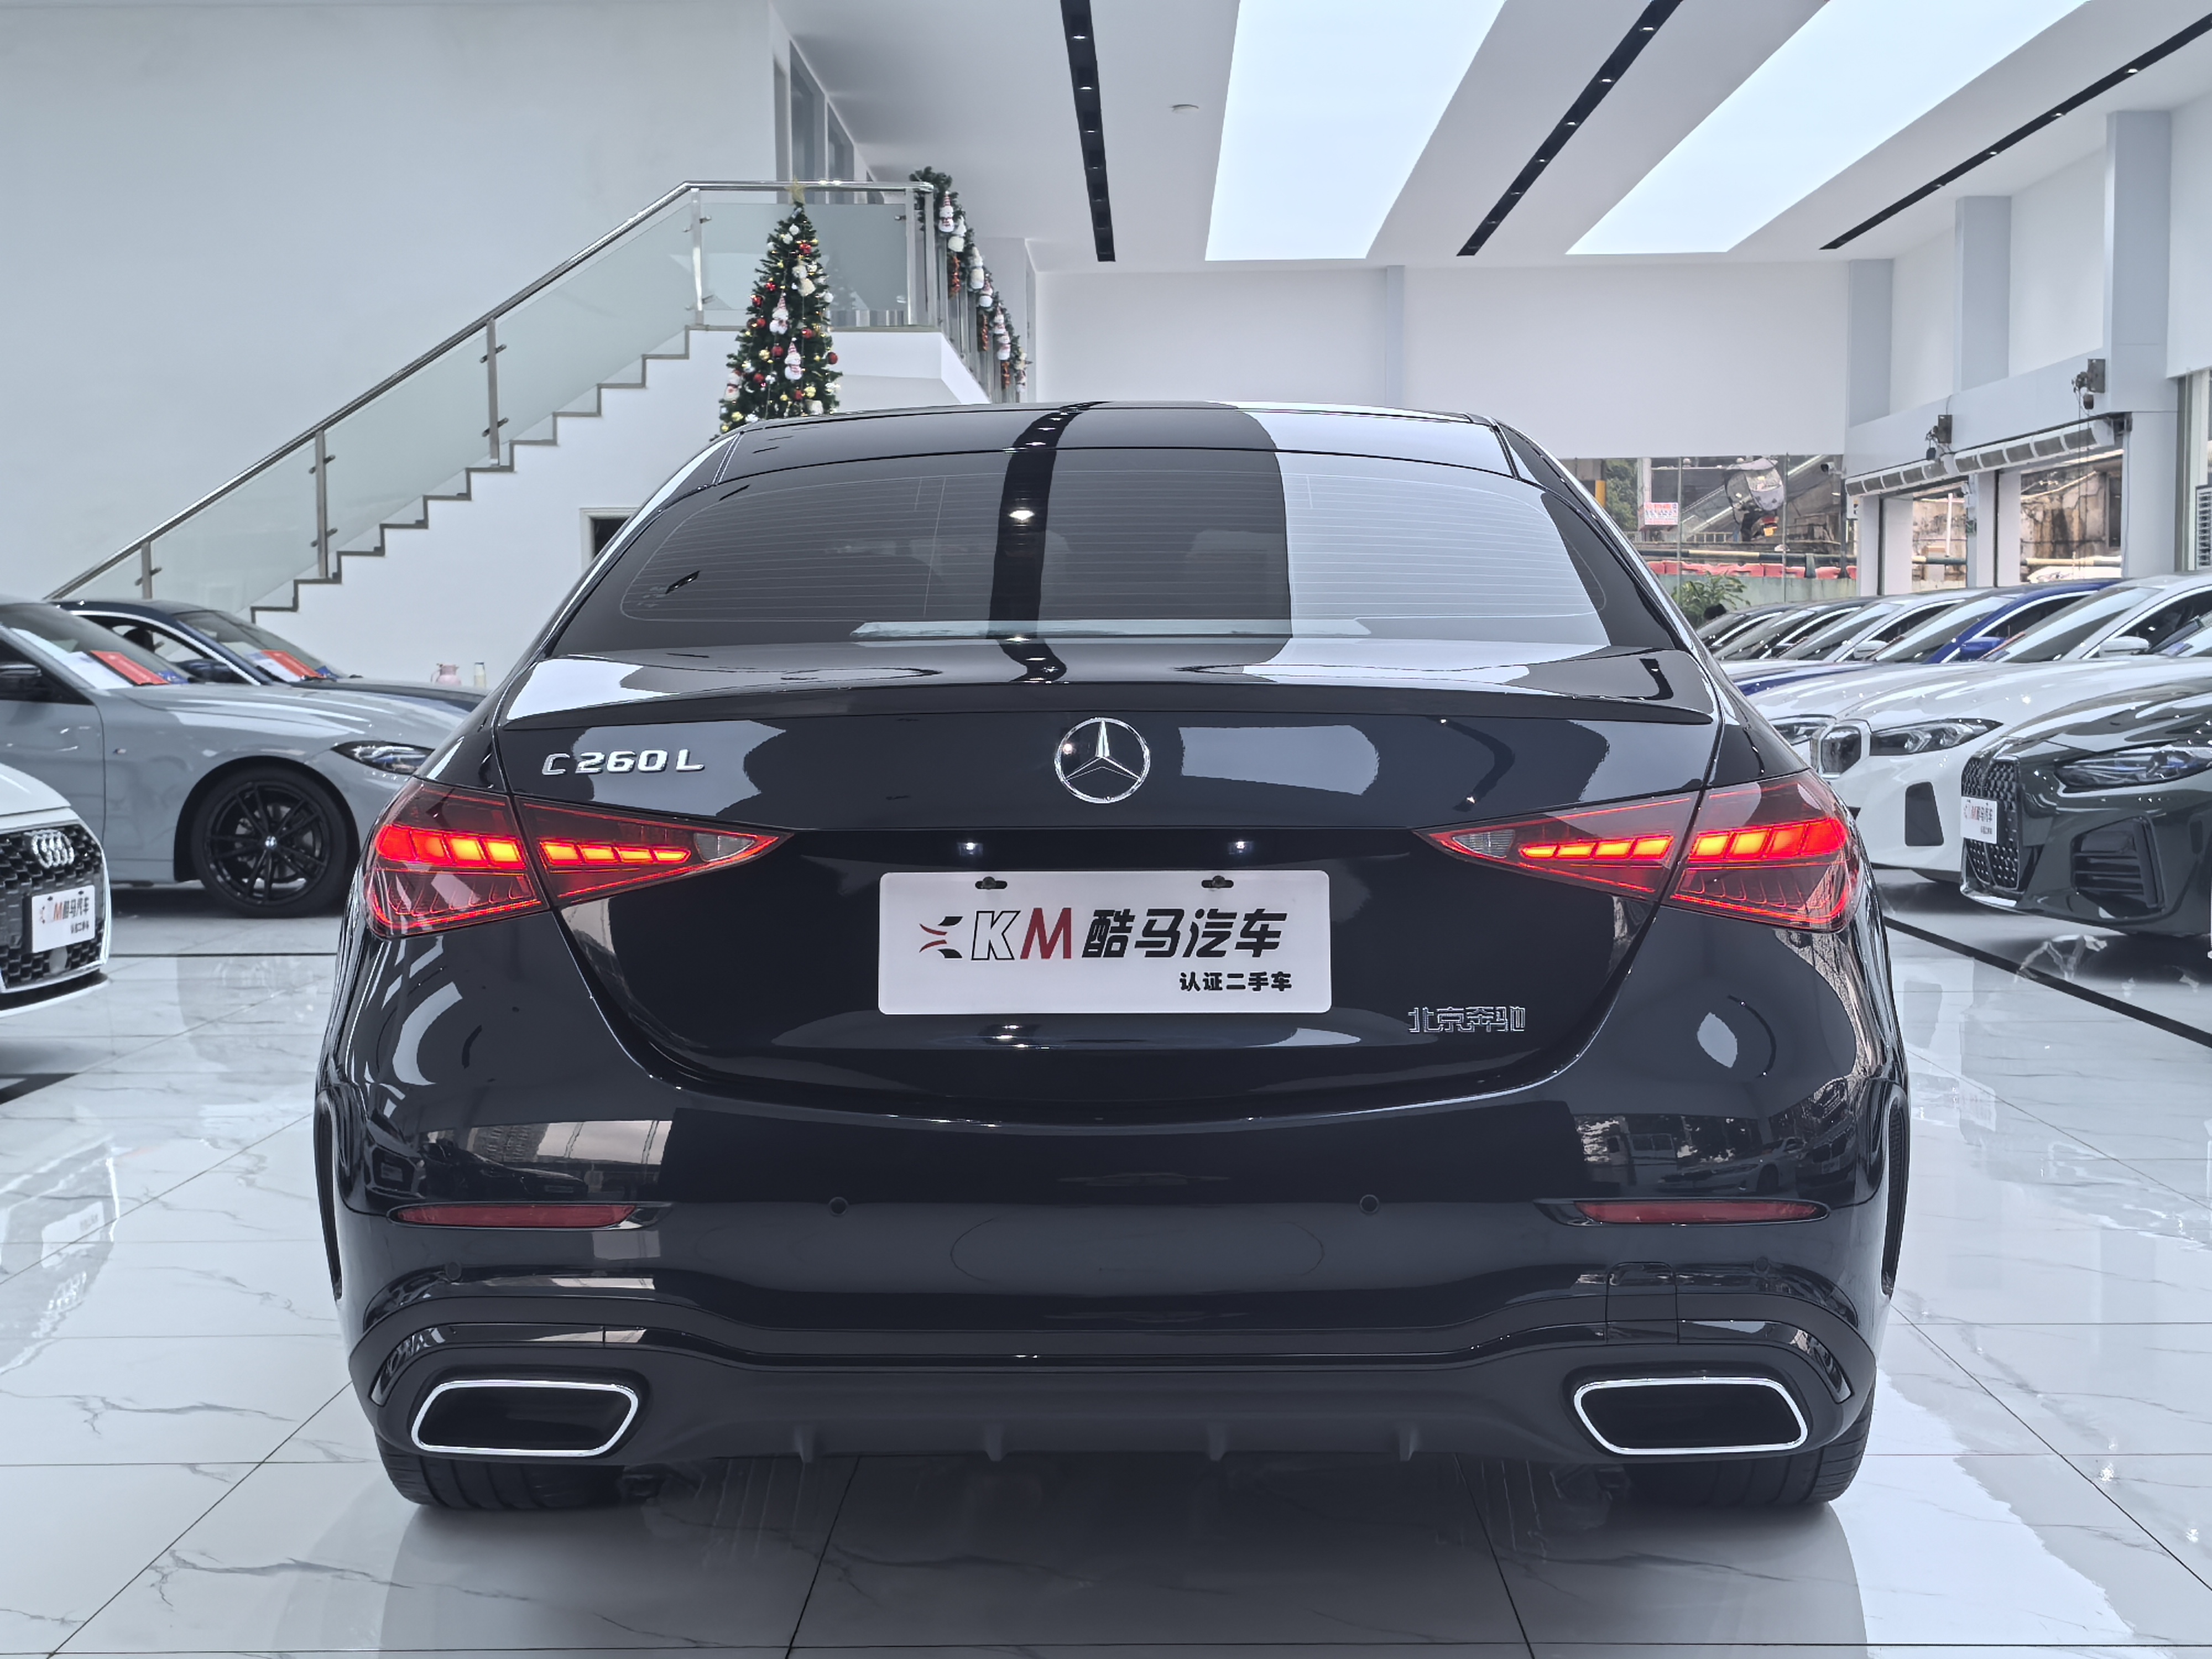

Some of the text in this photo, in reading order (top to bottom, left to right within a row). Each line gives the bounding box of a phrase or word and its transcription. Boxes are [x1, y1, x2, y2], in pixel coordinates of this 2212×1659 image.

[971, 907, 1288, 961] KM 酷马汽车
[1180, 971, 1292, 992] 认证二手车
[1408, 1006, 1526, 1032] 北京奔驰
